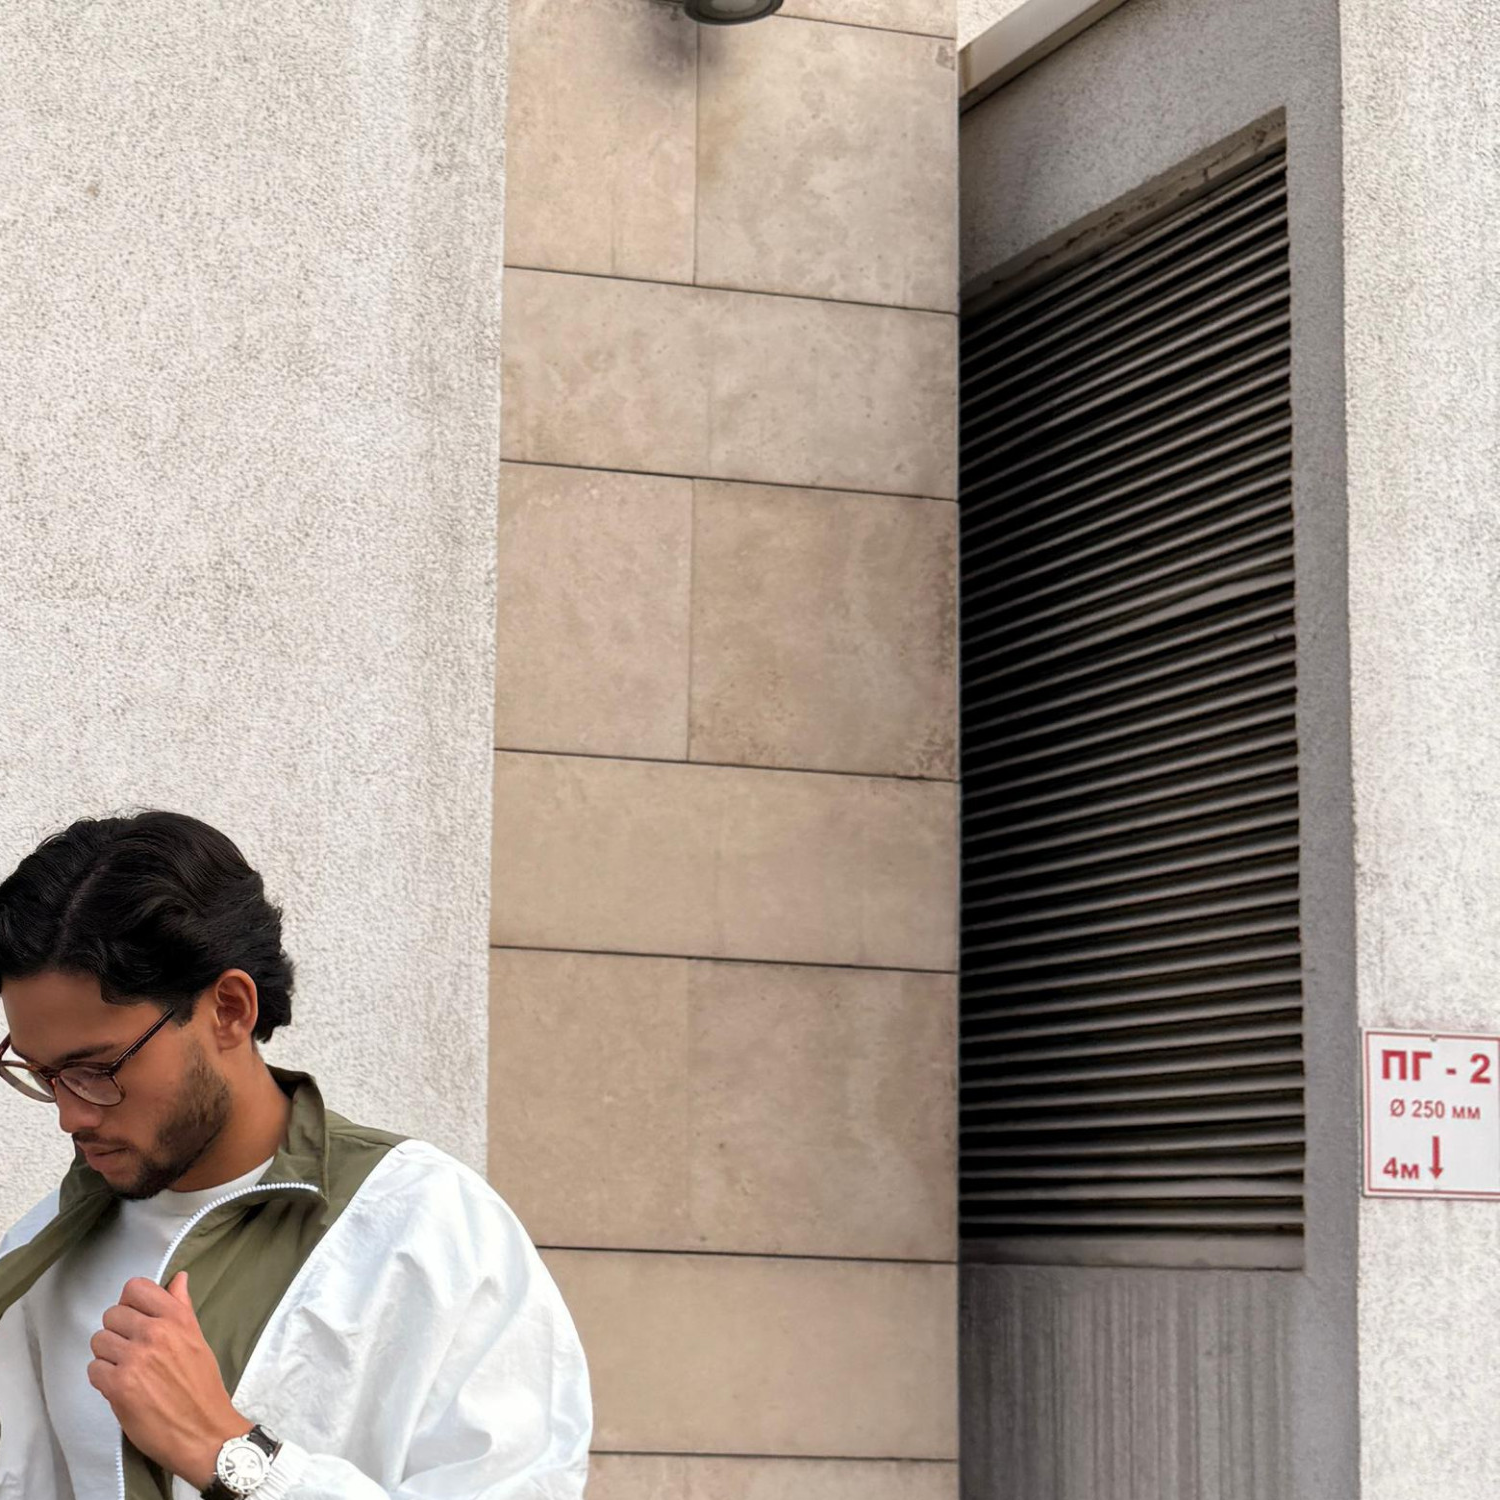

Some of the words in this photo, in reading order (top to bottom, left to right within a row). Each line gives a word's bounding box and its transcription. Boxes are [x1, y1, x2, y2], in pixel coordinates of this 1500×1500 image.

[1382, 1049, 1432, 1081] ПГ
[1470, 1053, 1492, 1084] 2
[1411, 1100, 1445, 1119] 250
[1452, 1106, 1481, 1120] мм
[1382, 1157, 1420, 1179] 4м
